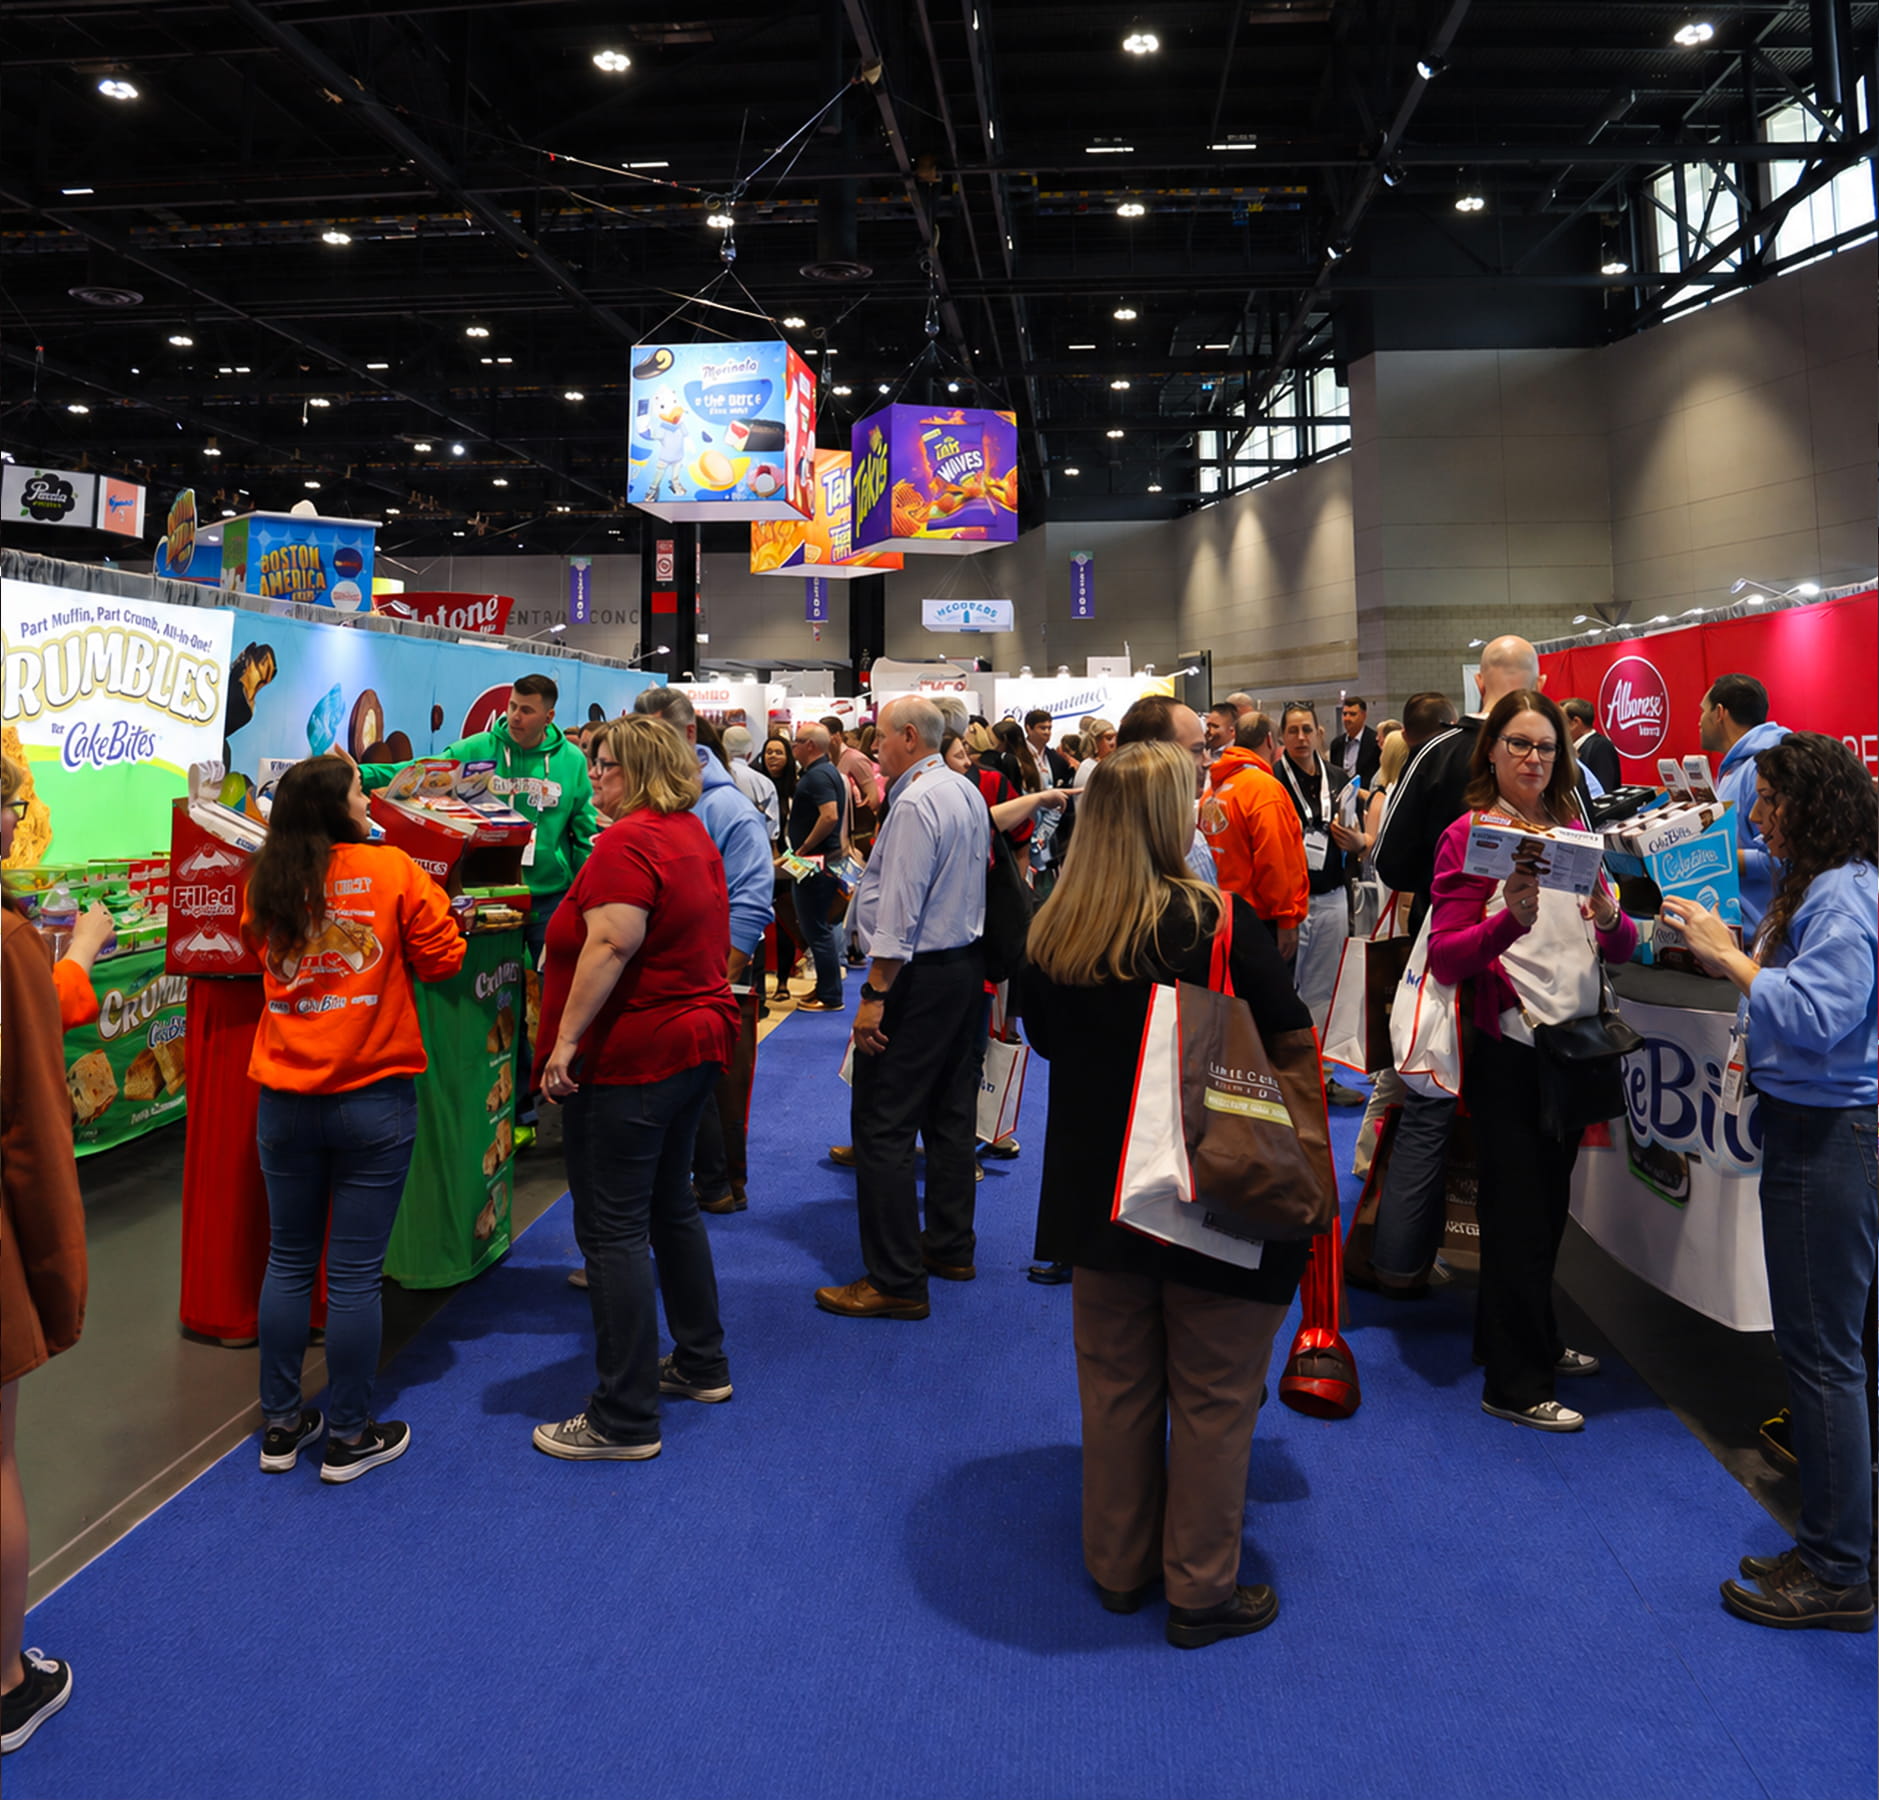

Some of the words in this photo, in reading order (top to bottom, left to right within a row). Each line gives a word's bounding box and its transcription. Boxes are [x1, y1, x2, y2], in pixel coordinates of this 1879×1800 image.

[937, 450, 983, 483] WAVES
[260, 545, 321, 574] BOSTON
[260, 569, 328, 597] AMERICA
[20, 620, 48, 638] Part
[52, 608, 94, 629] Muffin,
[97, 606, 121, 622] Part
[124, 609, 160, 634] Crumb,
[1, 629, 219, 724] RUMBLES
[64, 720, 156, 768] CakeBites
[173, 885, 236, 909] Filled
